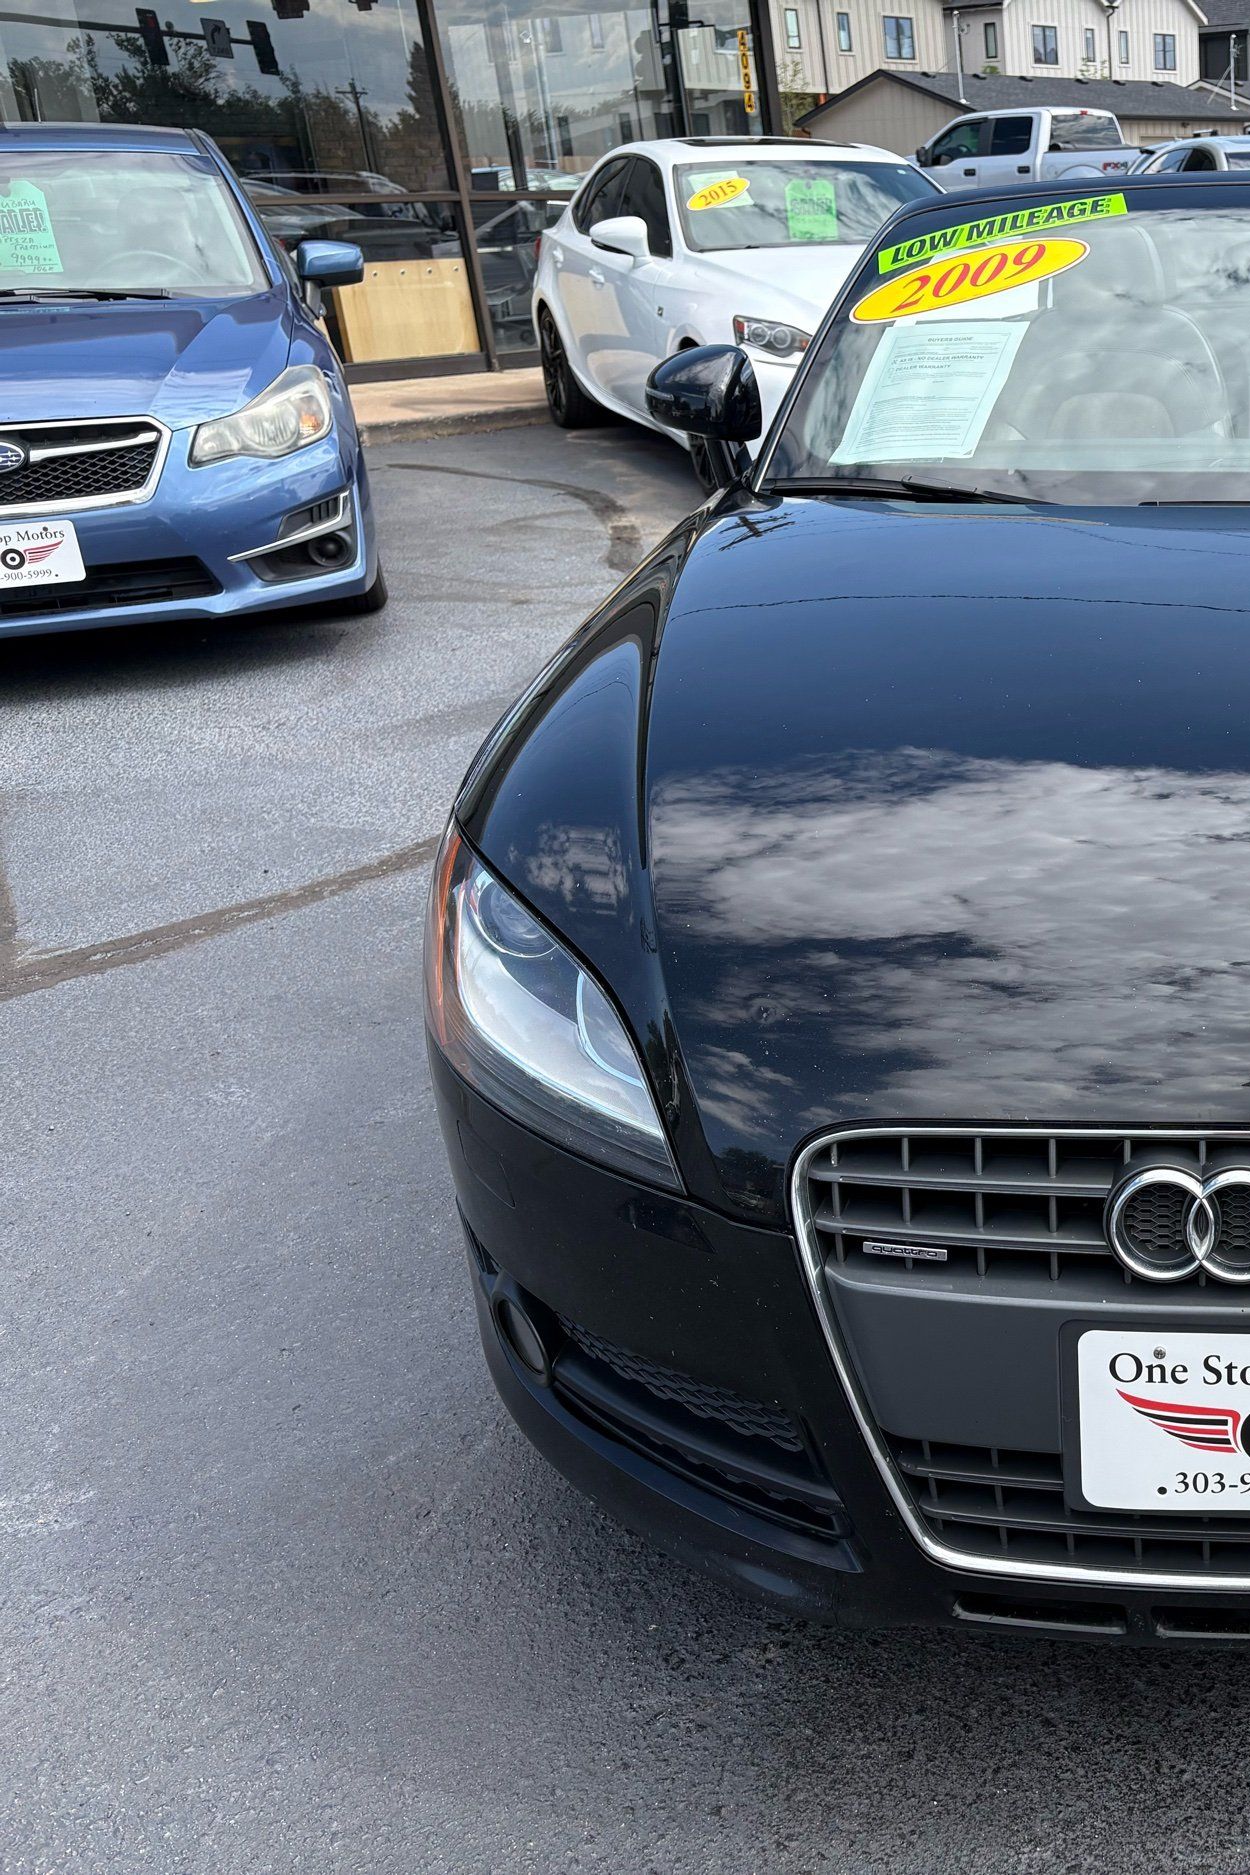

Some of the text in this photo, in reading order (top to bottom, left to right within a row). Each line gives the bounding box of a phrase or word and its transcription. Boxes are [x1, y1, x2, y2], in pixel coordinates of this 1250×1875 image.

[738, 31, 756, 112] 4094
[0, 199, 36, 208] UBARU
[699, 181, 738, 206] 2015
[0, 208, 47, 234] ALE!
[890, 197, 1112, 266] LOW MILEAGE
[890, 243, 1047, 314] 2009
[16, 529, 65, 542] Motors
[0, 568, 52, 581] -900-5999
[871, 1245, 938, 1257] quattro
[1108, 1352, 1189, 1385] One
